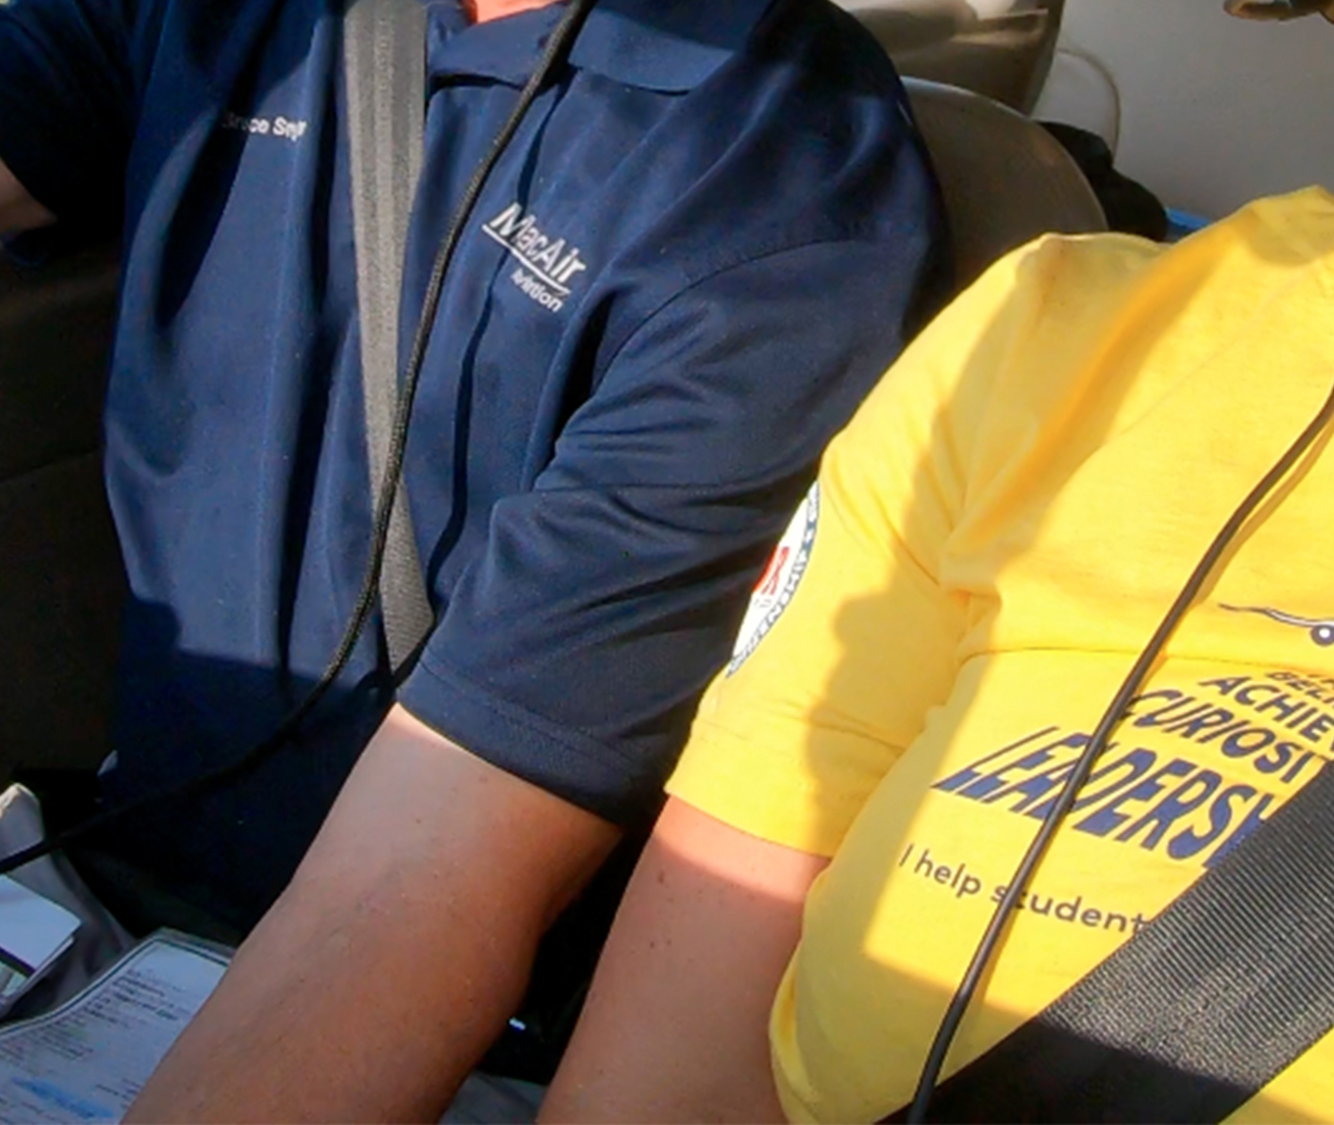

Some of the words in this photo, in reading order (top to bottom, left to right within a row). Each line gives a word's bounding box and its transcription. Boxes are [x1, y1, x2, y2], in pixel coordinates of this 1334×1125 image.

[489, 201, 587, 283] MacAir
[899, 843, 914, 867] I
[914, 849, 982, 899] help
[990, 884, 1150, 934] sudent
